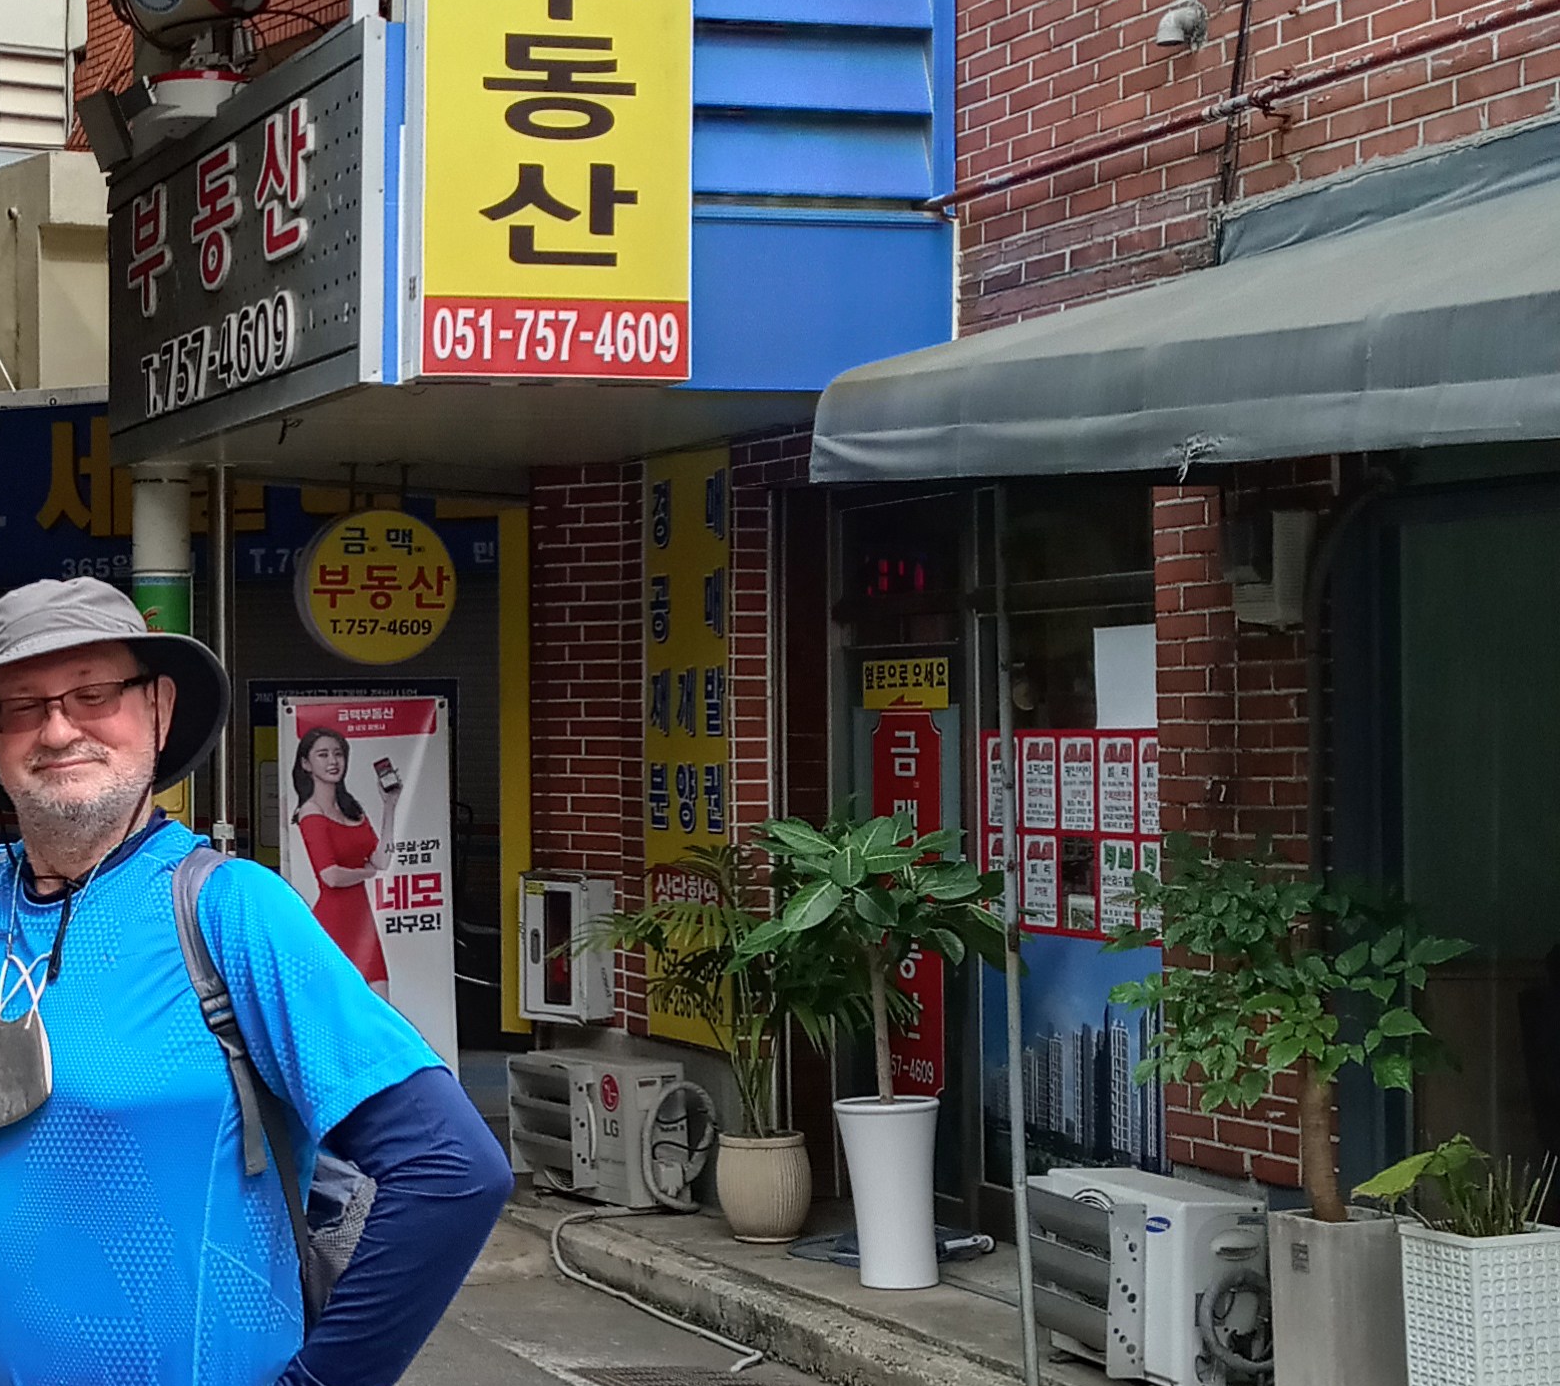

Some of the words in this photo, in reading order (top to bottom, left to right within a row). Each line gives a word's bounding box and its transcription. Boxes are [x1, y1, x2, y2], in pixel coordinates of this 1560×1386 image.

[128, 98, 315, 317] 부동산
[433, 306, 680, 364] 051-757-4609
[141, 290, 295, 418] T.757-4609
[313, 564, 450, 610] 부동산
[330, 619, 432, 635] T.757-4609
[865, 664, 908, 689] 옆문으로
[912, 662, 946, 688] 오세요
[337, 707, 394, 721] 금맥부동산
[651, 665, 725, 737] 재개발
[649, 761, 724, 833] 분양권
[398, 854, 418, 865] 구할
[421, 853, 431, 863] 때
[376, 873, 443, 910] 네모
[386, 913, 441, 933] 라구요!
[604, 1119, 619, 1137] LG
